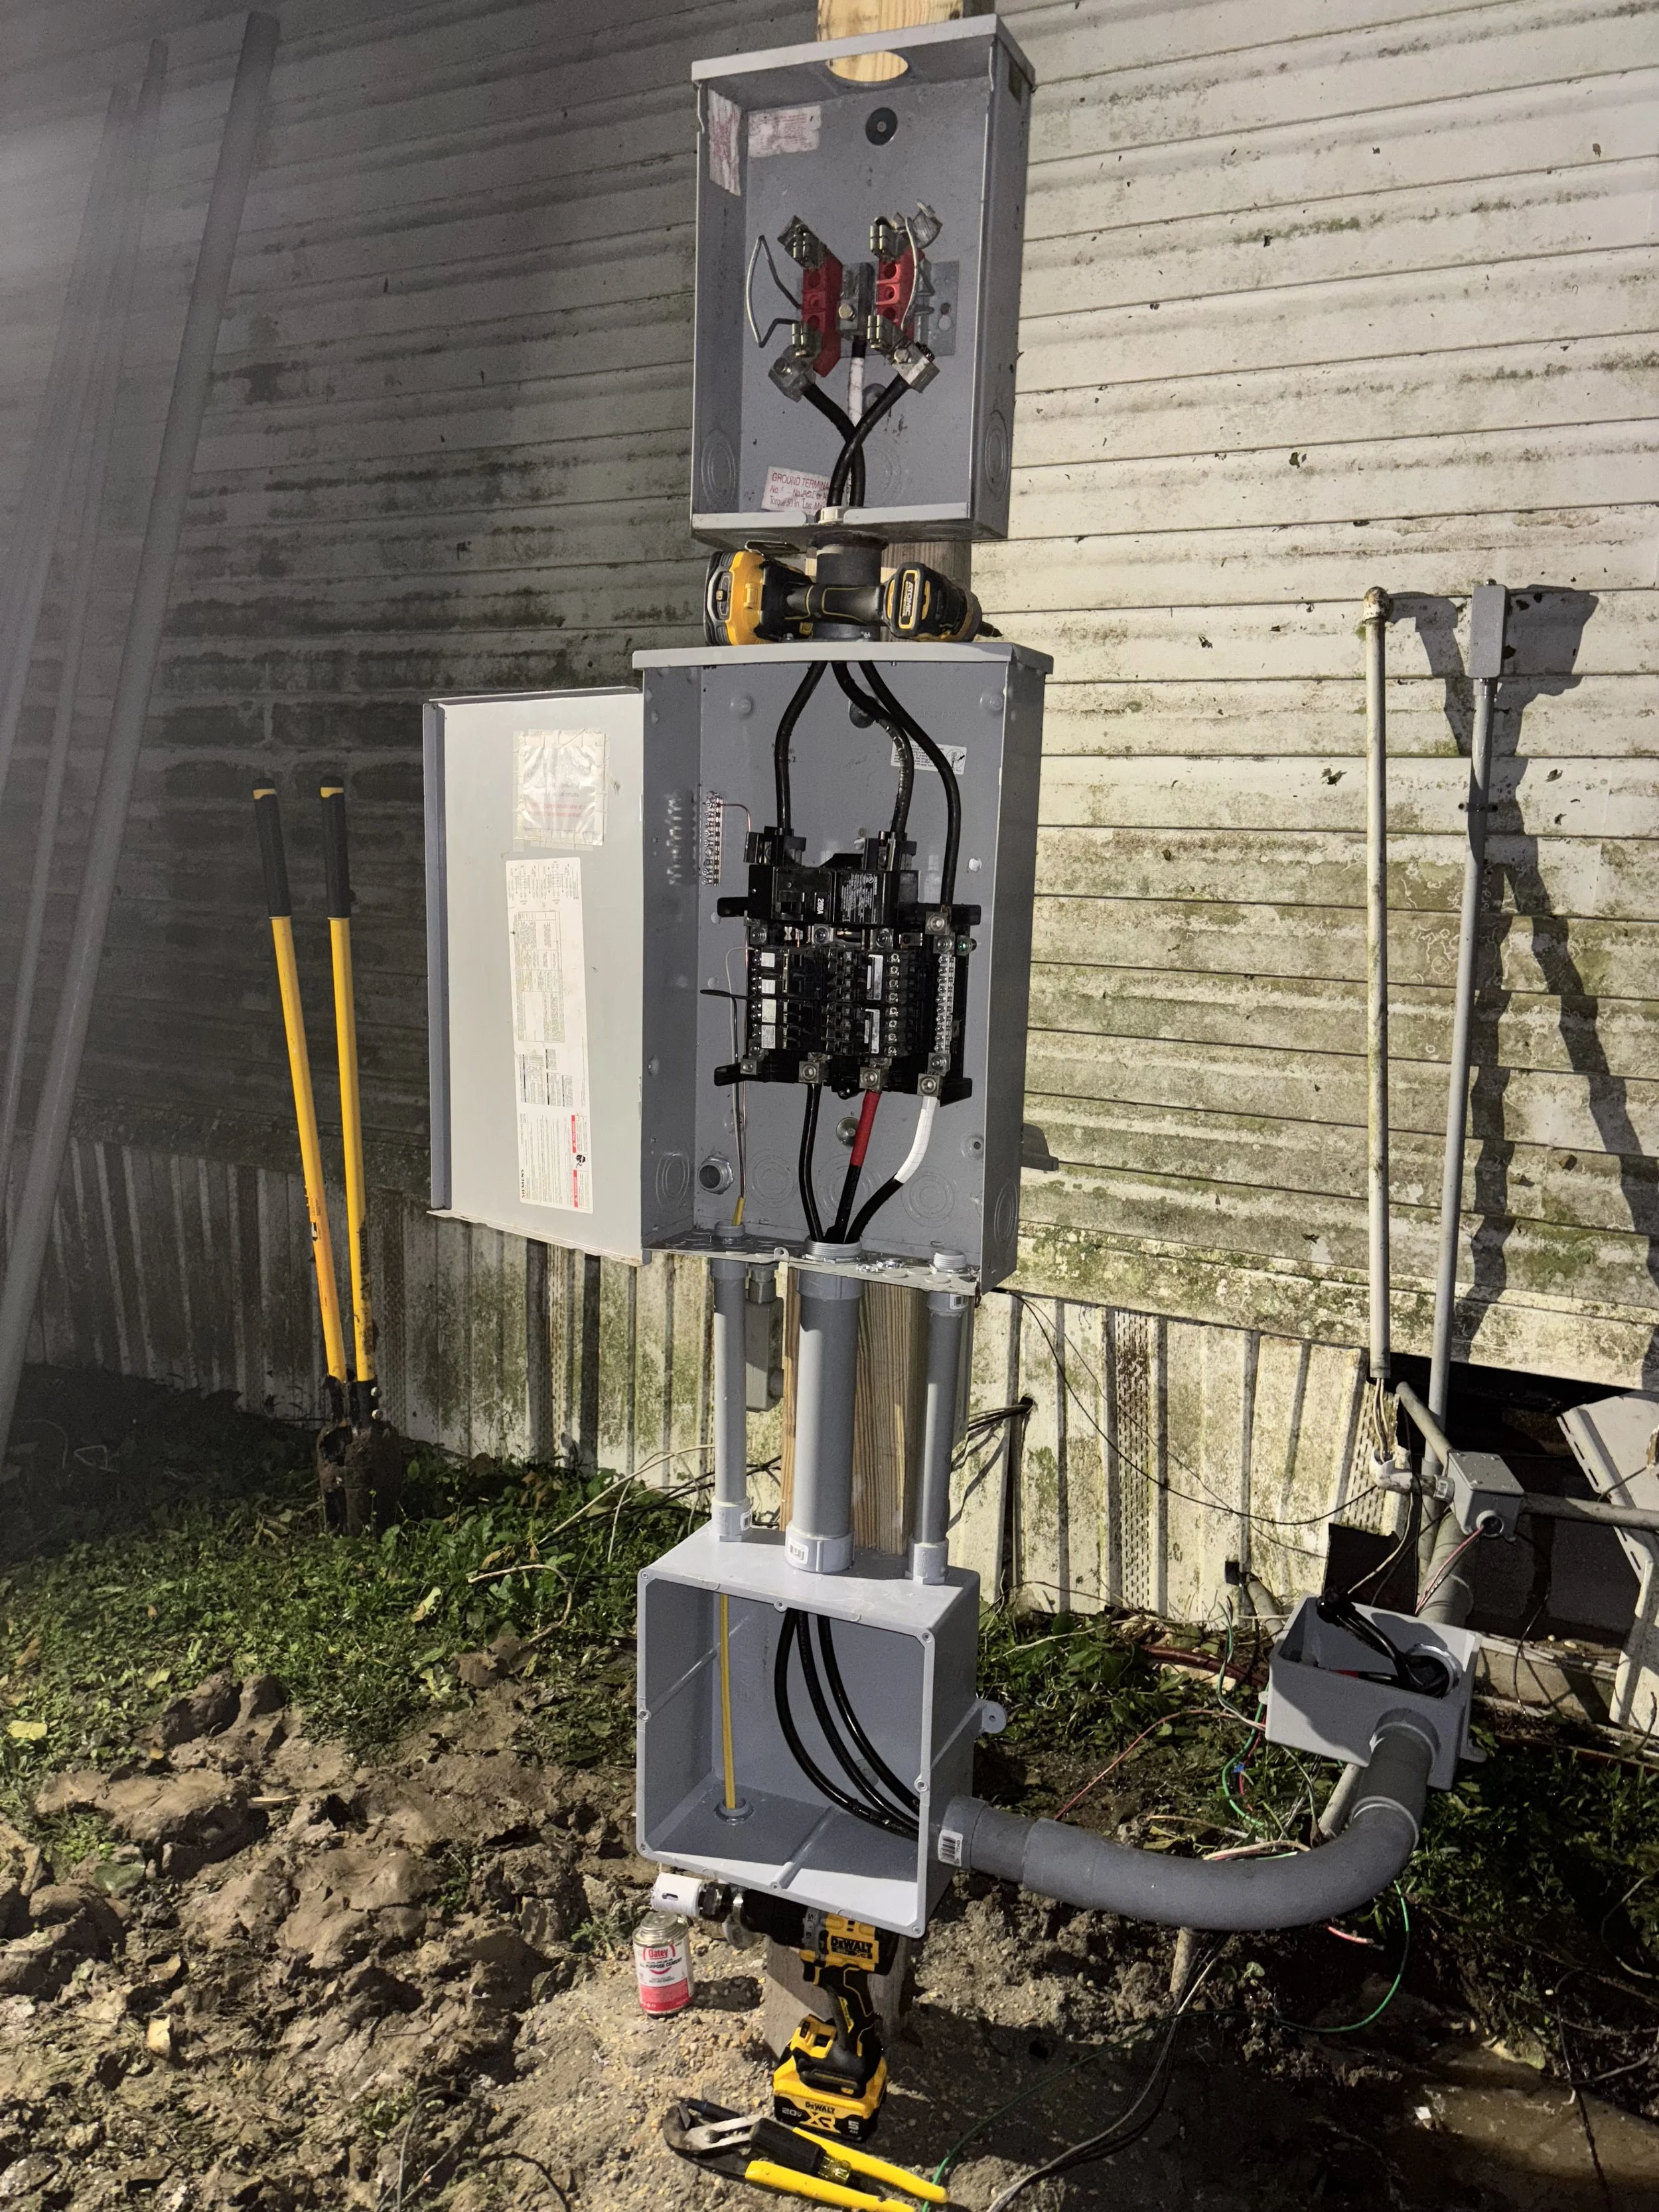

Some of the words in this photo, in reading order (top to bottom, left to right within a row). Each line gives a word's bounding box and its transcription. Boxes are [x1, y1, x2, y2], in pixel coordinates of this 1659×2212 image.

[772, 473, 800, 486] GROUND
[802, 478, 830, 490] TERMINA
[905, 581, 914, 617] ATOMIC
[648, 1949, 668, 1958] Oatey
[666, 1957, 682, 1967] CEMENT
[847, 2120, 859, 2130] 5
